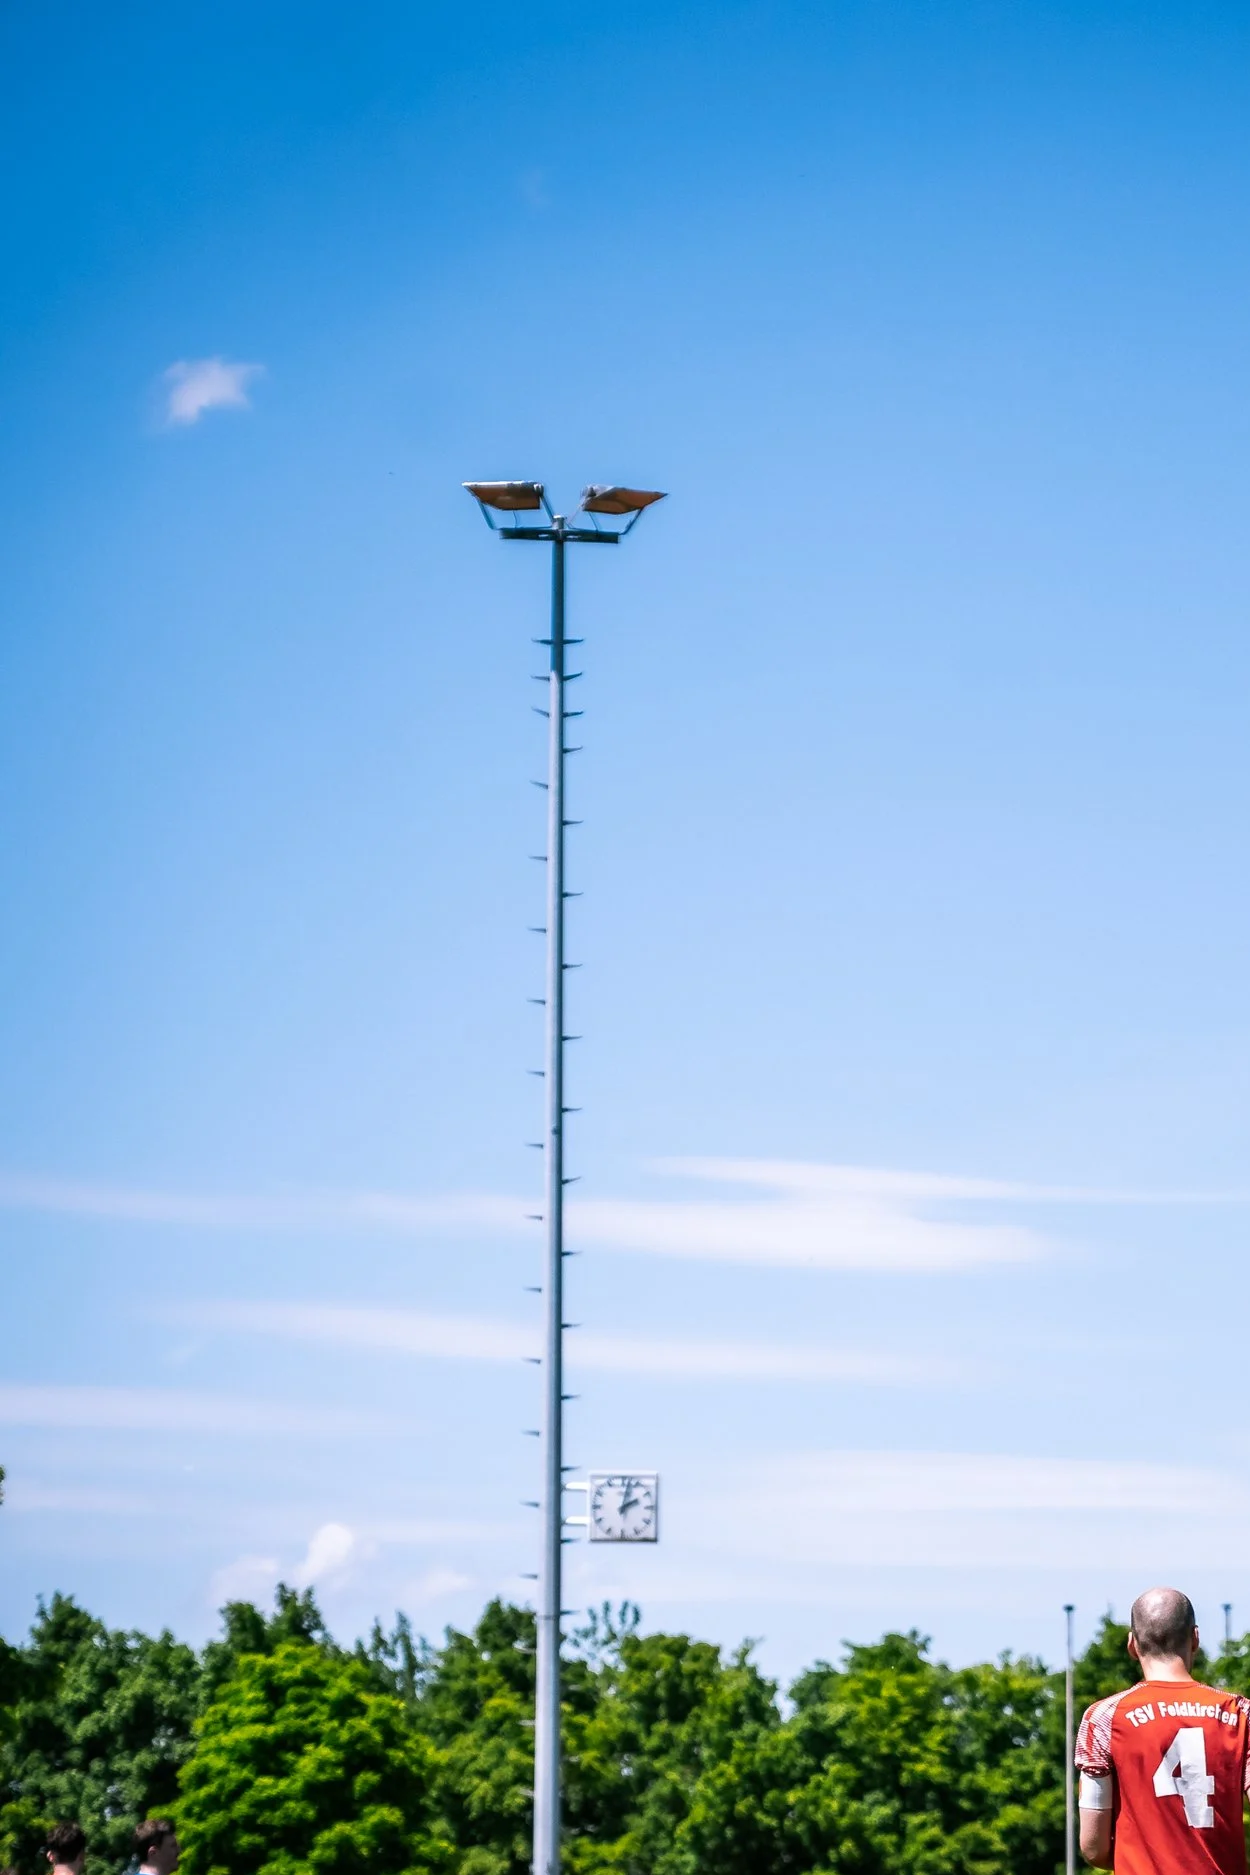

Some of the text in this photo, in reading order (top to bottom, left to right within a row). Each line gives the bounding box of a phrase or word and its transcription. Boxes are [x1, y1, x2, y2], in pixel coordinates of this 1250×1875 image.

[1125, 1702, 1237, 1727] TSV Feldkirchen
[1153, 1727, 1214, 1827] 4
